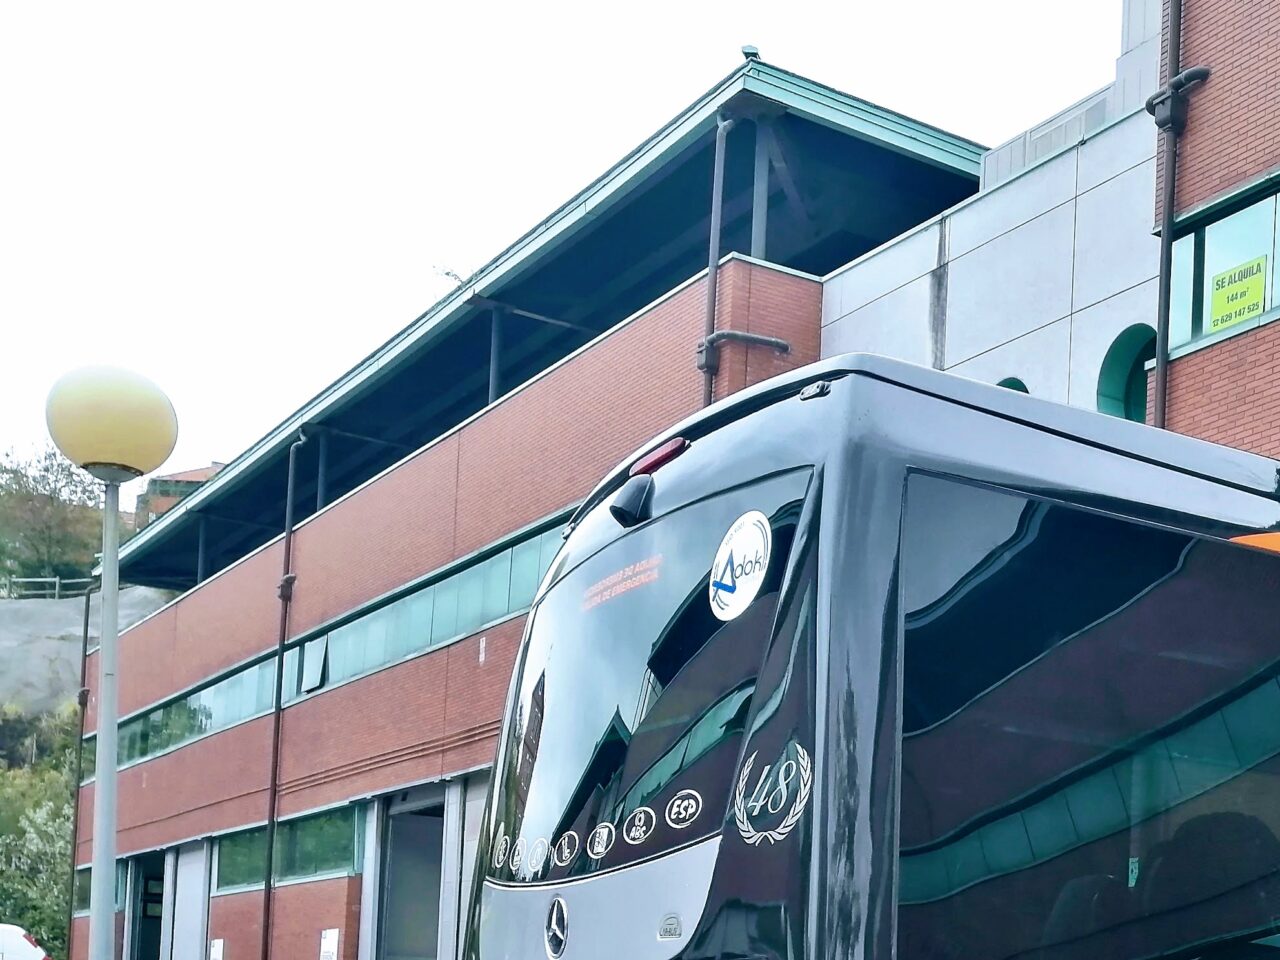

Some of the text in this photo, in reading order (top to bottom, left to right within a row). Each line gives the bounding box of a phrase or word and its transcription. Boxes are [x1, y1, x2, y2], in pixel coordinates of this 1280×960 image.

[1215, 262, 1262, 291] SE ALQUILA
[1226, 291, 1239, 304] 144
[1220, 301, 1260, 324] 629 147 525
[747, 760, 797, 817] 48
[670, 799, 697, 820] ESP
[629, 828, 647, 840] ABS
